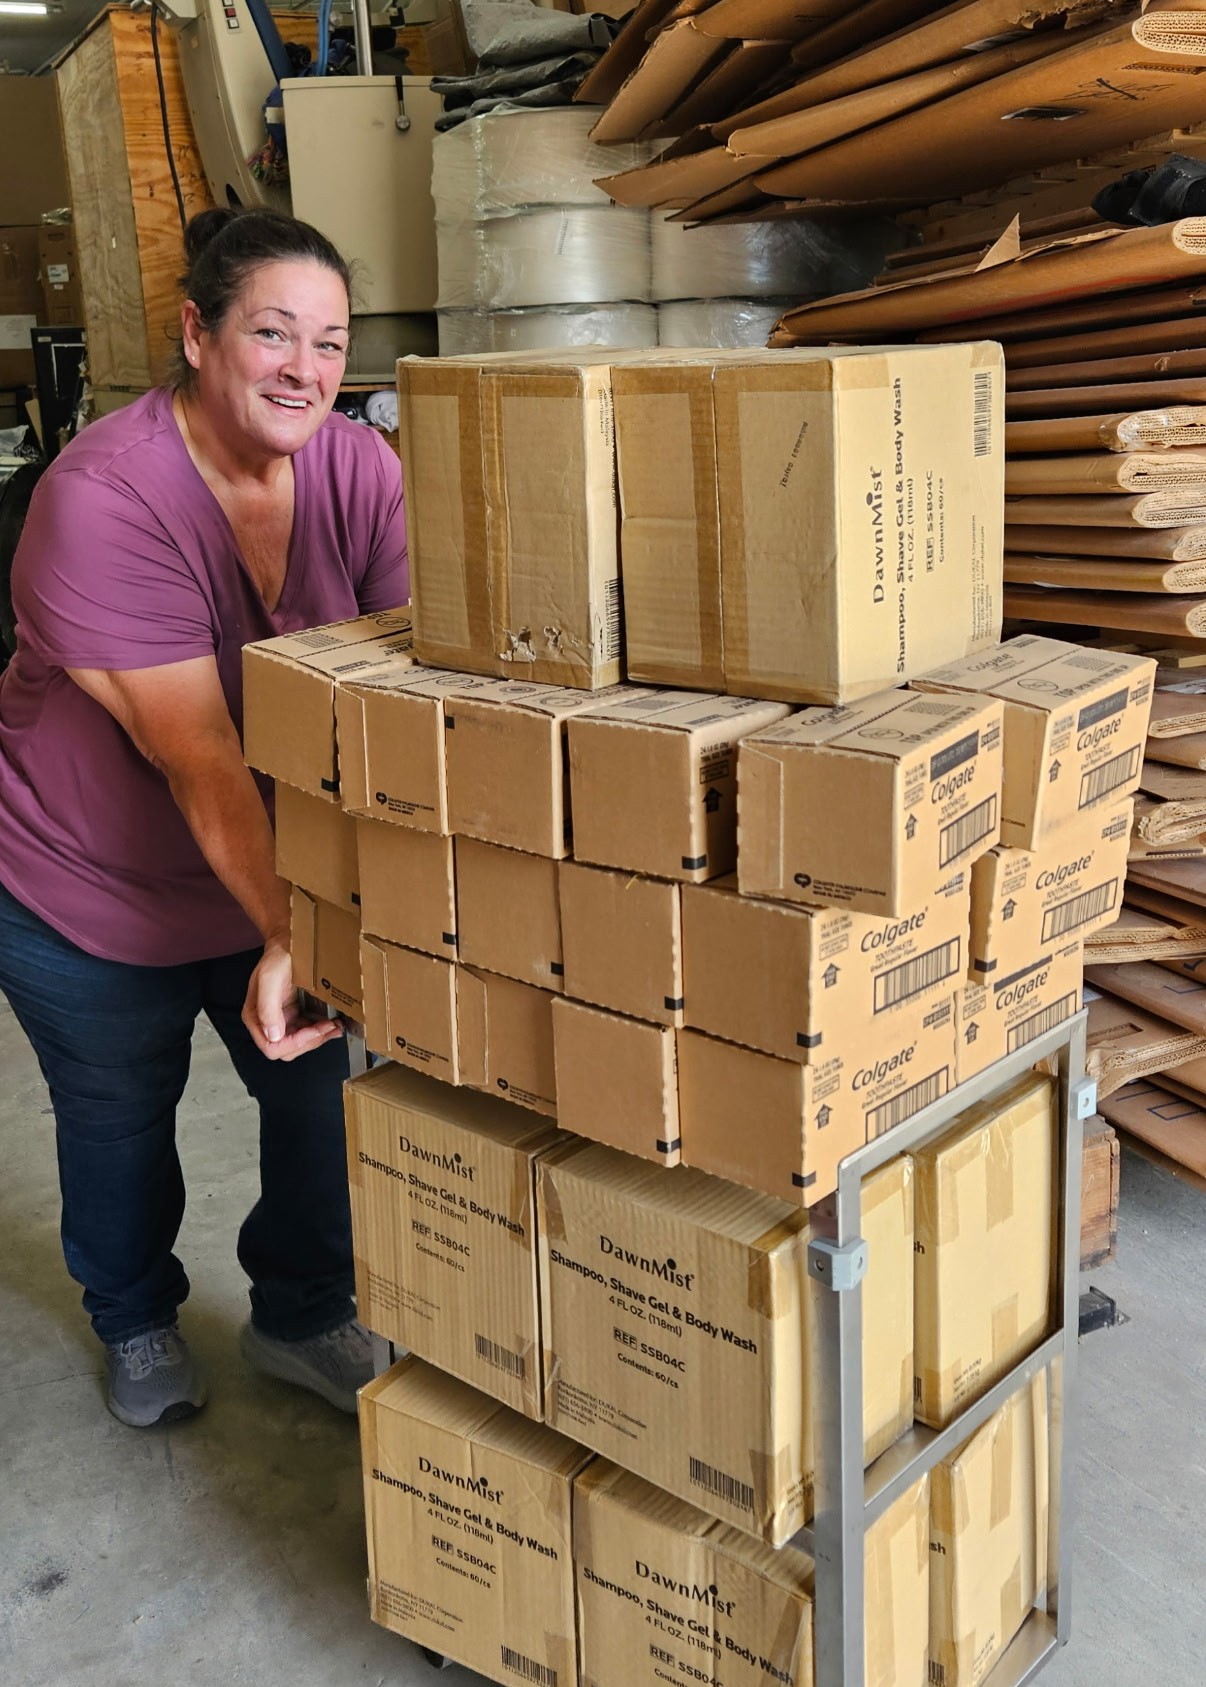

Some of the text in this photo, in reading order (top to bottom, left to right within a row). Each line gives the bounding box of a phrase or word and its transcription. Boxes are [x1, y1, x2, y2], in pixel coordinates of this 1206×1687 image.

[866, 469, 884, 603] DawnMist
[894, 378, 906, 673] Shampoo, Shave Gel & Body Wash
[908, 554, 914, 572] FL
[908, 574, 914, 582] 4
[967, 653, 1013, 672] Colgate
[1077, 718, 1121, 752] Colgate
[931, 766, 975, 804] Colgate
[1035, 854, 1092, 890] Colgate
[860, 912, 926, 952] Colgate
[996, 972, 1048, 1010] Colgate
[852, 1046, 915, 1091] Colgate
[400, 1136, 474, 1182] DawnMist
[359, 1152, 524, 1237] Shampoo, Shave Gel & Body Wash
[408, 1190, 468, 1224] 4 FL OZ. (118ml)
[412, 1220, 470, 1257] REF SSB04C
[416, 1242, 465, 1272] Contents: 60/cs
[600, 1235, 692, 1291] DawnMist
[551, 1249, 758, 1354] Shampoo, Shave Gel & Body Wash
[609, 1295, 682, 1338] 4 FL OZ. (118ml)
[614, 1328, 686, 1372] REF SSB04C
[618, 1352, 679, 1388] Contents: 60/cs
[419, 1456, 502, 1506] DawnMist
[372, 1468, 558, 1560] Shampoo, Shave Gel & Body Wash
[428, 1508, 494, 1545] 4 FL OZ. (118ml)
[432, 1536, 496, 1574] REF SSB04C
[436, 1558, 491, 1588] Contents: 60/cs
[636, 1560, 733, 1618] DawnMist
[584, 1567, 794, 1687] Shampoo, Shave Gel & Body Wash
[645, 1615, 722, 1660] 4 FL OZ. (118ml)
[650, 1645, 674, 1668] REF
